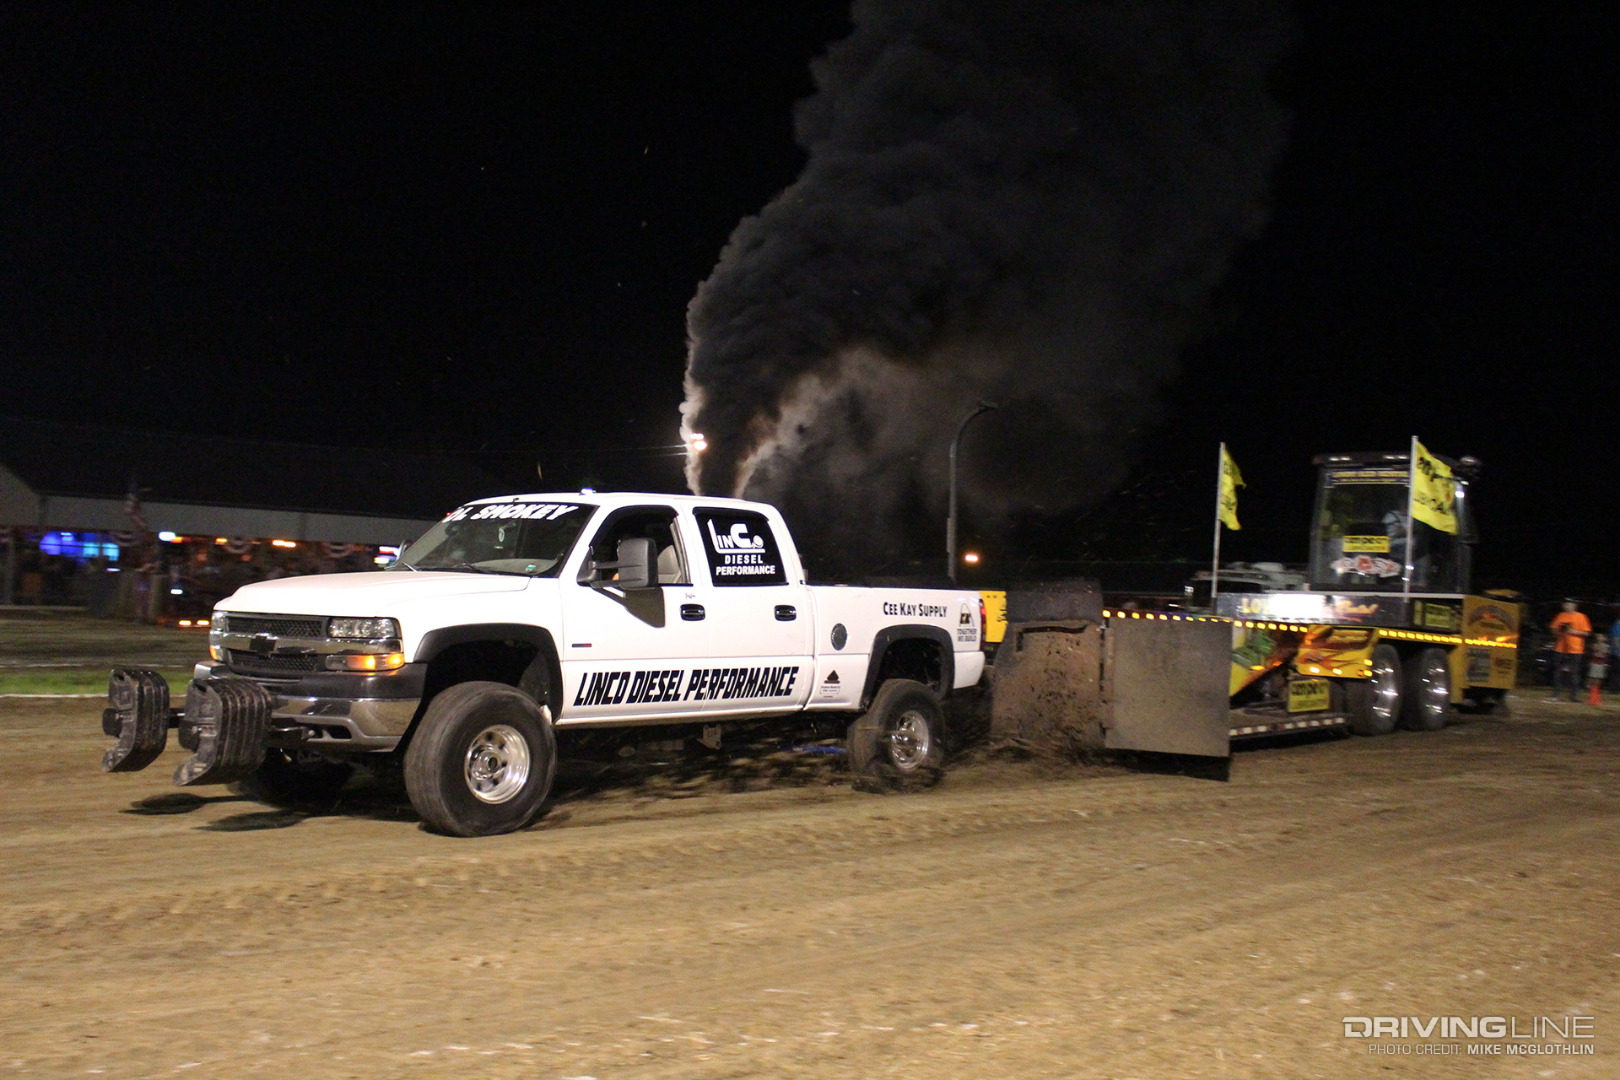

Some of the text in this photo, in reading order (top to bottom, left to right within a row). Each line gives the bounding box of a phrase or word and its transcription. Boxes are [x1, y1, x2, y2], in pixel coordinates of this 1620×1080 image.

[470, 504, 579, 520] SMOKEY
[724, 554, 764, 565] DIESEL
[715, 564, 776, 576] PERFORMANCE
[573, 666, 799, 706] LINCO DIESEL PERFORMANCE
